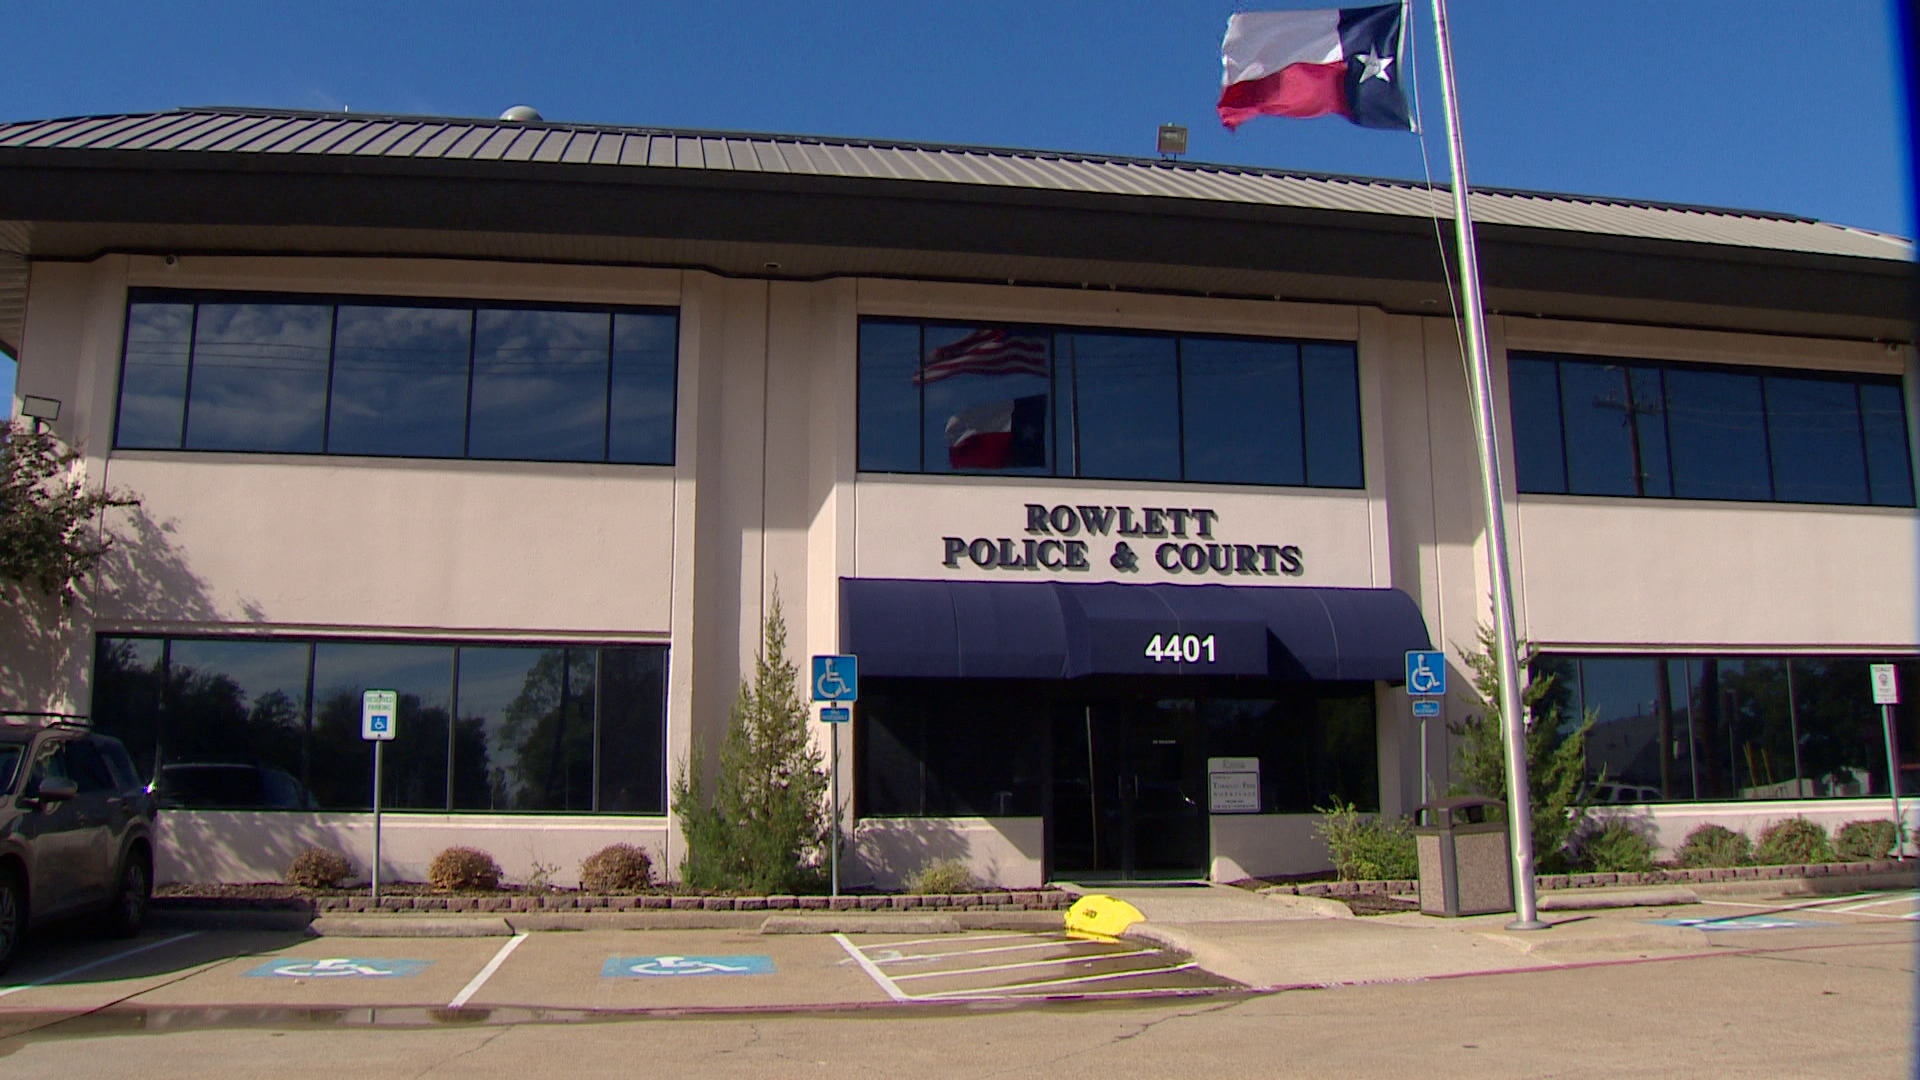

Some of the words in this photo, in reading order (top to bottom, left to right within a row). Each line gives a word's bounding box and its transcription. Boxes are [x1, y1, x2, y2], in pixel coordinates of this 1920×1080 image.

[1024, 503, 1217, 538] ROWLETT
[942, 536, 1089, 570] POLICE
[1110, 541, 1138, 572] &
[1155, 542, 1303, 575] COURTS
[1145, 634, 1216, 663] 4401
